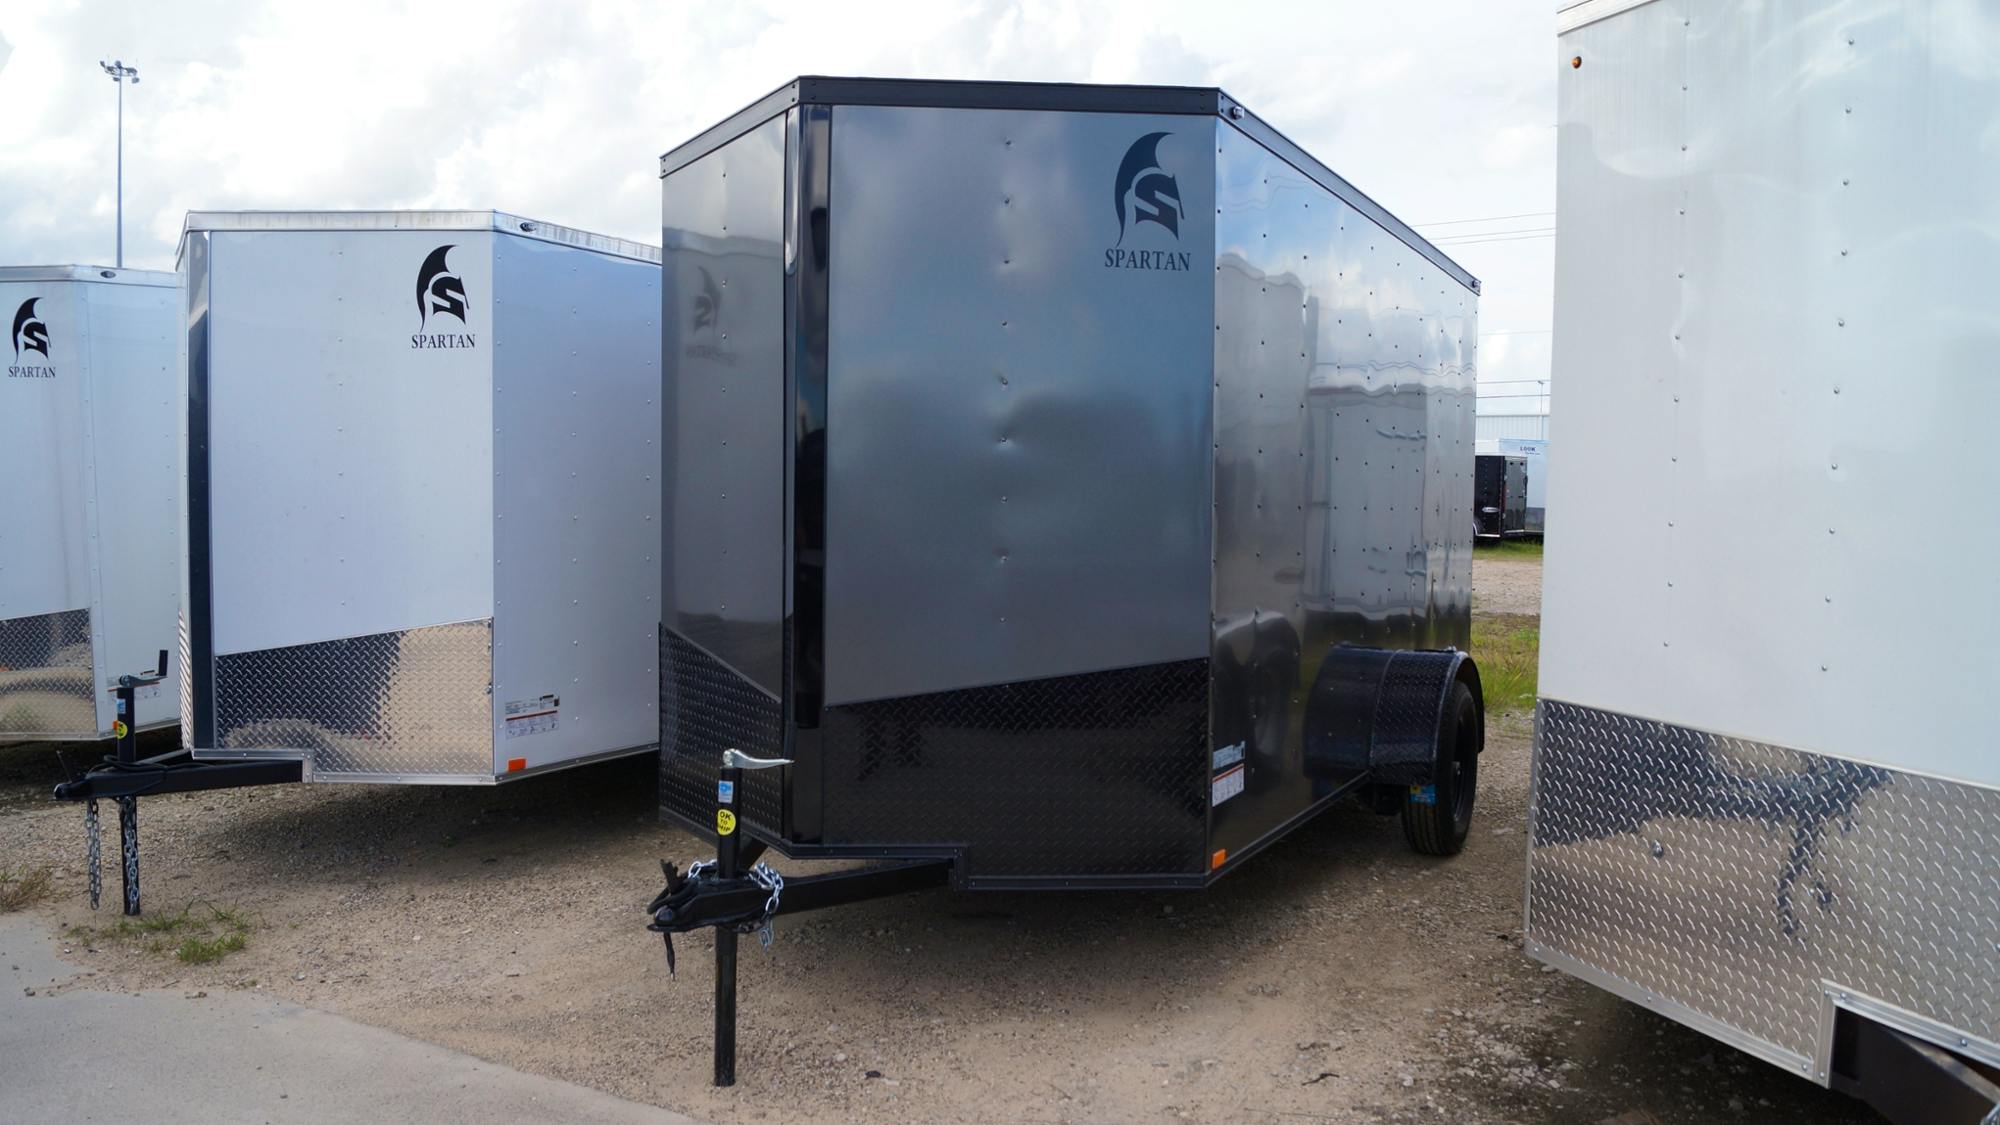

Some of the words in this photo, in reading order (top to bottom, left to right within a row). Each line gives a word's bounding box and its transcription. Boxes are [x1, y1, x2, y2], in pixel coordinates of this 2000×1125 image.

[1104, 248, 1191, 271] SPARTAN
[411, 334, 476, 349] SPARTAN
[8, 366, 56, 378] SPARTAN
[719, 811, 731, 821] OK
